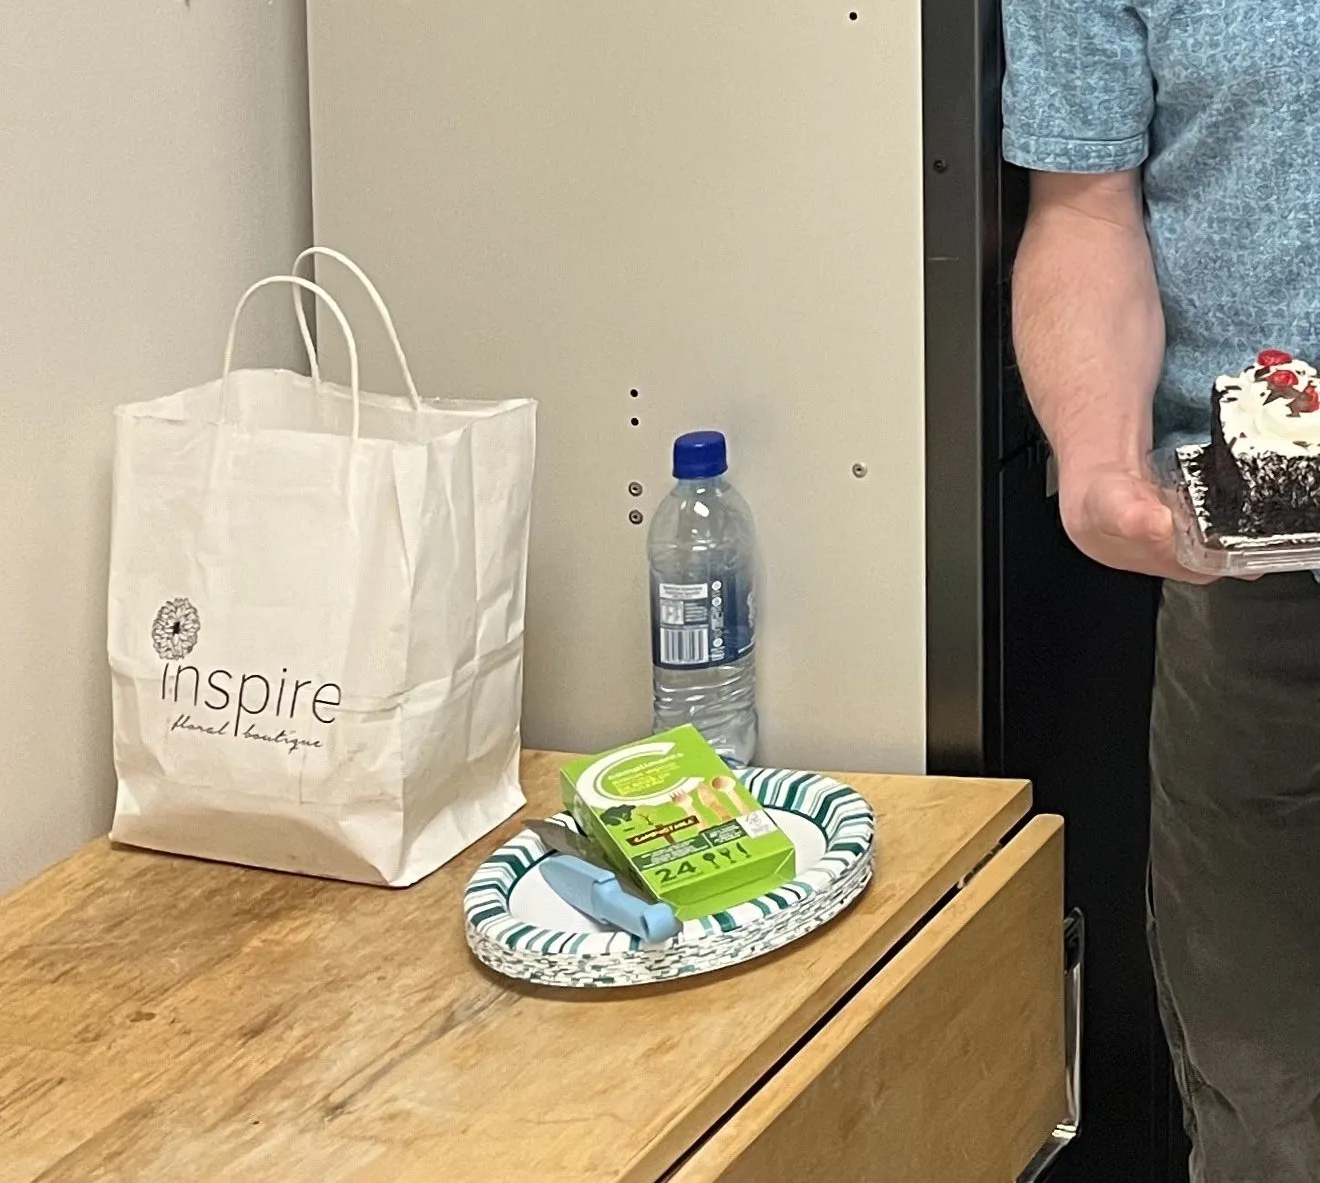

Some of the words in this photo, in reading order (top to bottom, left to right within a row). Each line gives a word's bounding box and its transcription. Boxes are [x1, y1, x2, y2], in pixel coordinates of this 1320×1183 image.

[161, 661, 342, 738] inspire
[170, 713, 231, 736] floral
[242, 723, 324, 755] boutique
[654, 860, 697, 884] 24
